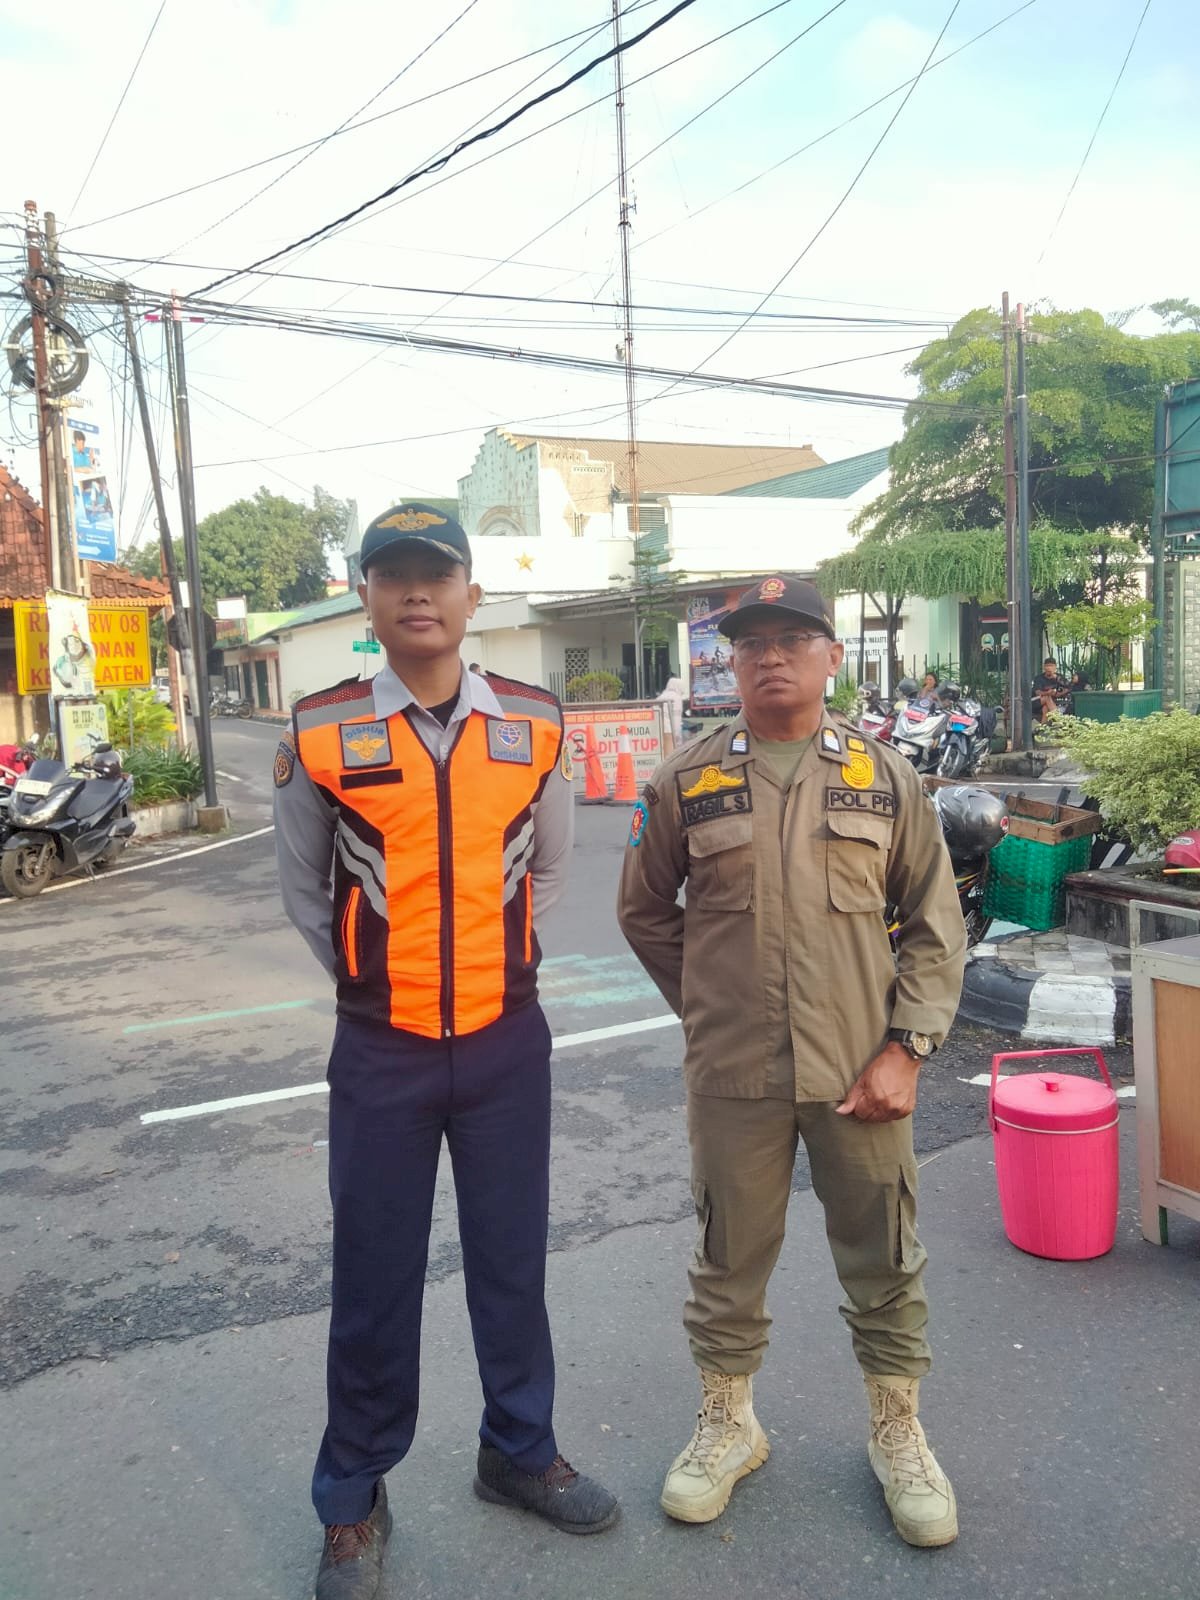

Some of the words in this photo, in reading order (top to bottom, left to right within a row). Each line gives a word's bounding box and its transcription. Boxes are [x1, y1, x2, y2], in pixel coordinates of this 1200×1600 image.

[120, 614, 140, 633] 08
[345, 725, 385, 739] DISHUB
[599, 738, 659, 754] DITTUP
[493, 750, 529, 761] DISHUB
[734, 794, 746, 810] S
[830, 791, 867, 807] POL
[872, 794, 894, 811] PP
